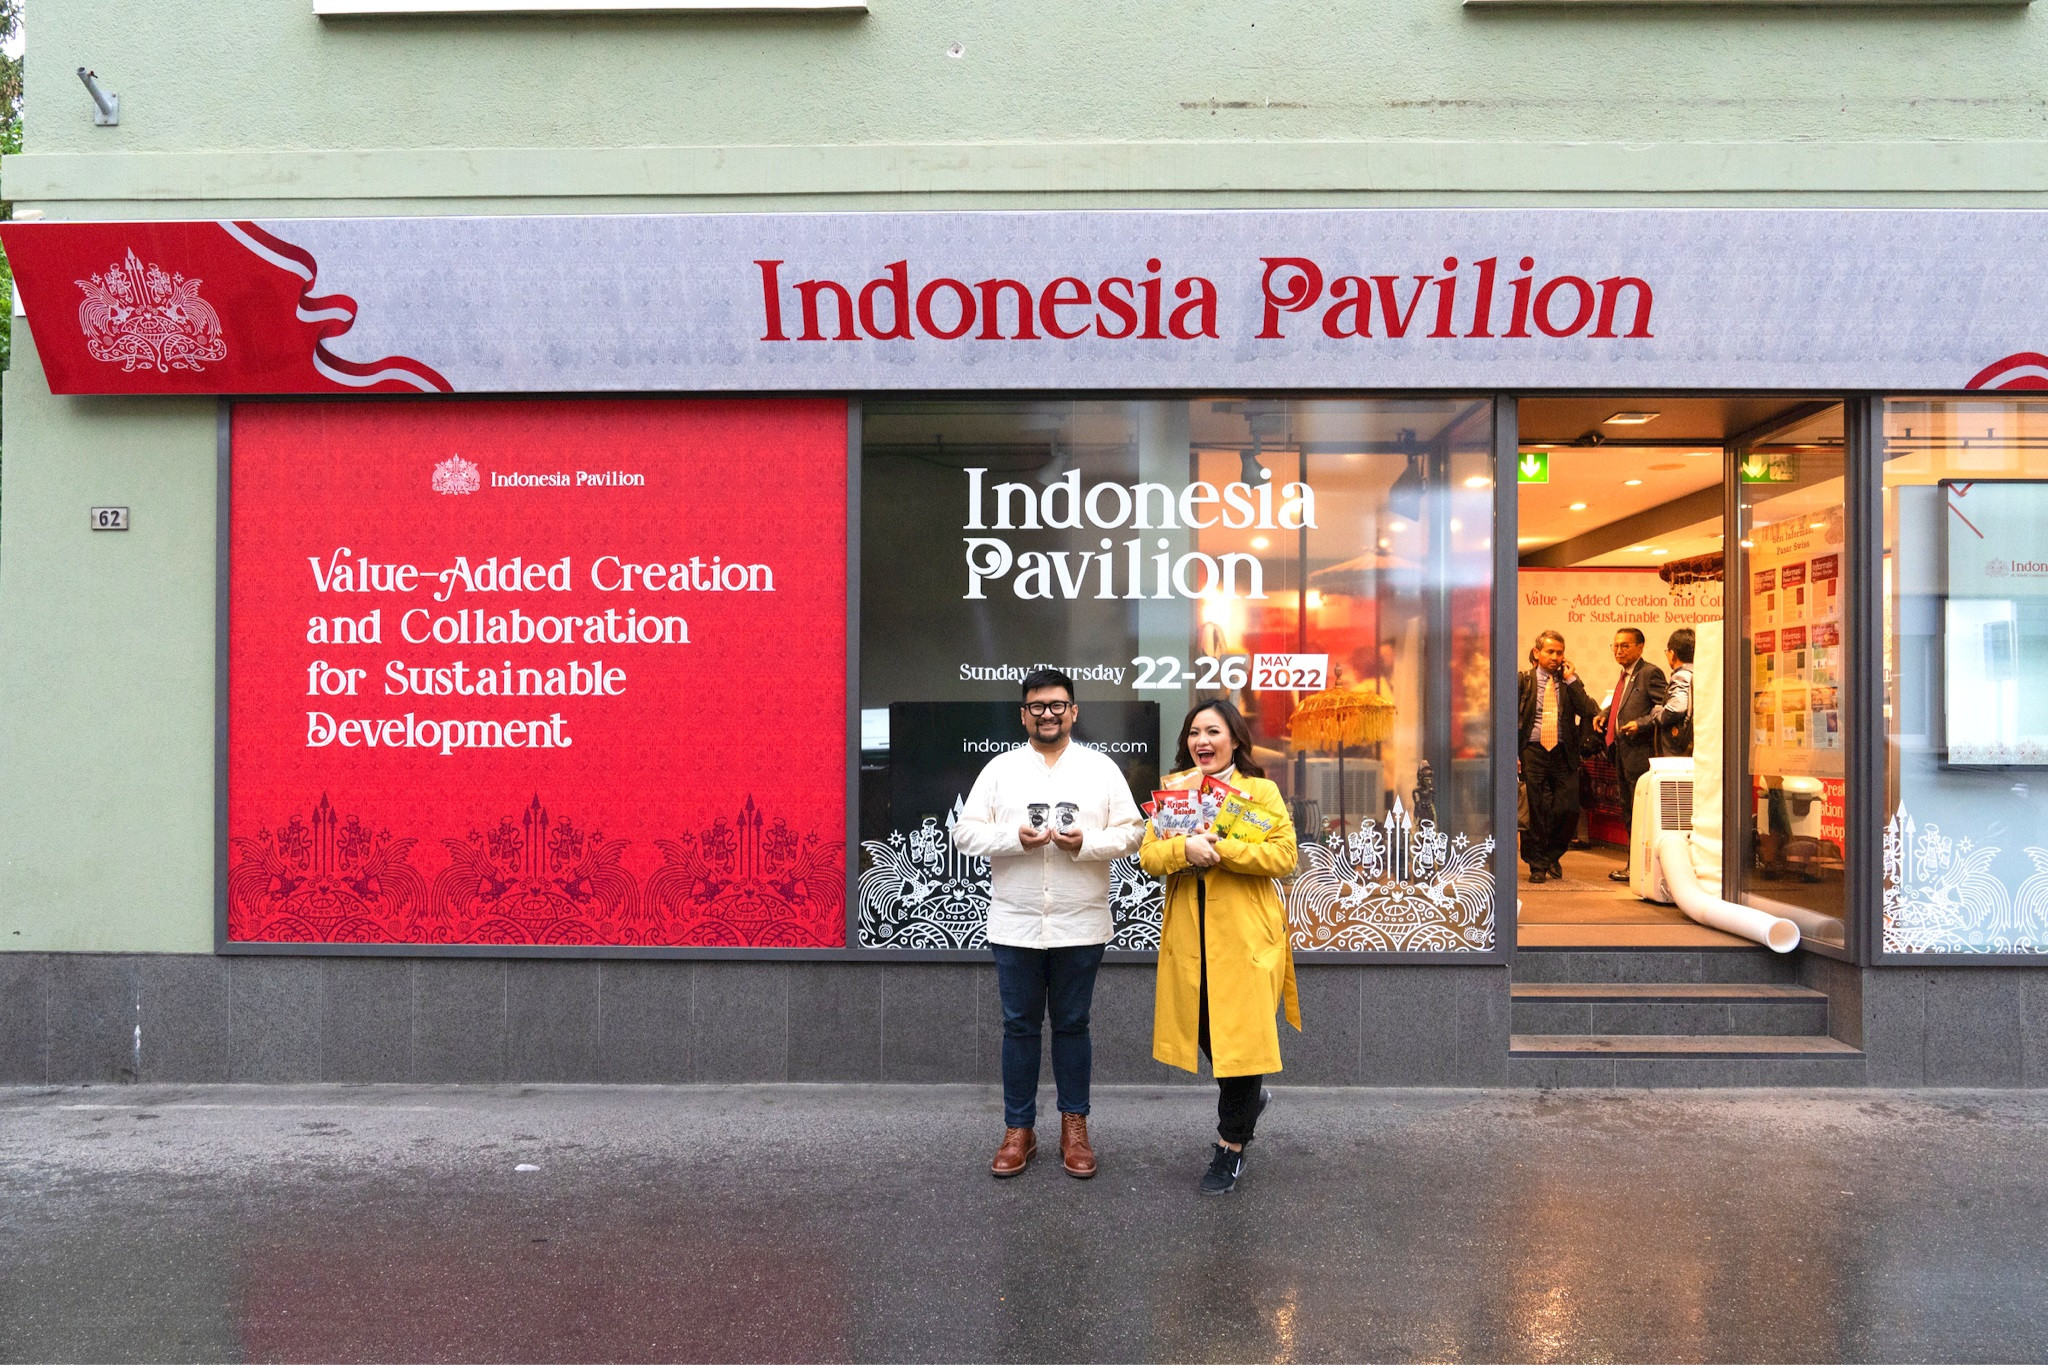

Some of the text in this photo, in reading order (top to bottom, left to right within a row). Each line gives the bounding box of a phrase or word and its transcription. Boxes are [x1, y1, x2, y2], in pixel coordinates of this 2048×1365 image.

[754, 256, 1654, 341] Indonesia Pavilion
[490, 470, 645, 487] Indonesia Pavilion
[962, 467, 1318, 531] Indonesia
[99, 510, 121, 527] 62
[1793, 540, 1810, 551] Swiss
[307, 546, 776, 602] Value-Added Creation
[962, 537, 1269, 600] Pavilion
[1525, 590, 1558, 606] Value
[1570, 593, 1611, 609] Added
[1615, 595, 1668, 607] Creation
[1673, 595, 1695, 607] and
[306, 607, 691, 644] and Collaboration
[1567, 610, 1586, 623] for
[1590, 610, 1660, 623] Sustainable
[1130, 655, 1248, 690] 22-26
[1260, 656, 1293, 667] MAY
[306, 660, 627, 696] for Sustainable
[1259, 669, 1322, 688] 2022
[305, 711, 573, 756] Development
[1167, 800, 1189, 809] Kripik
